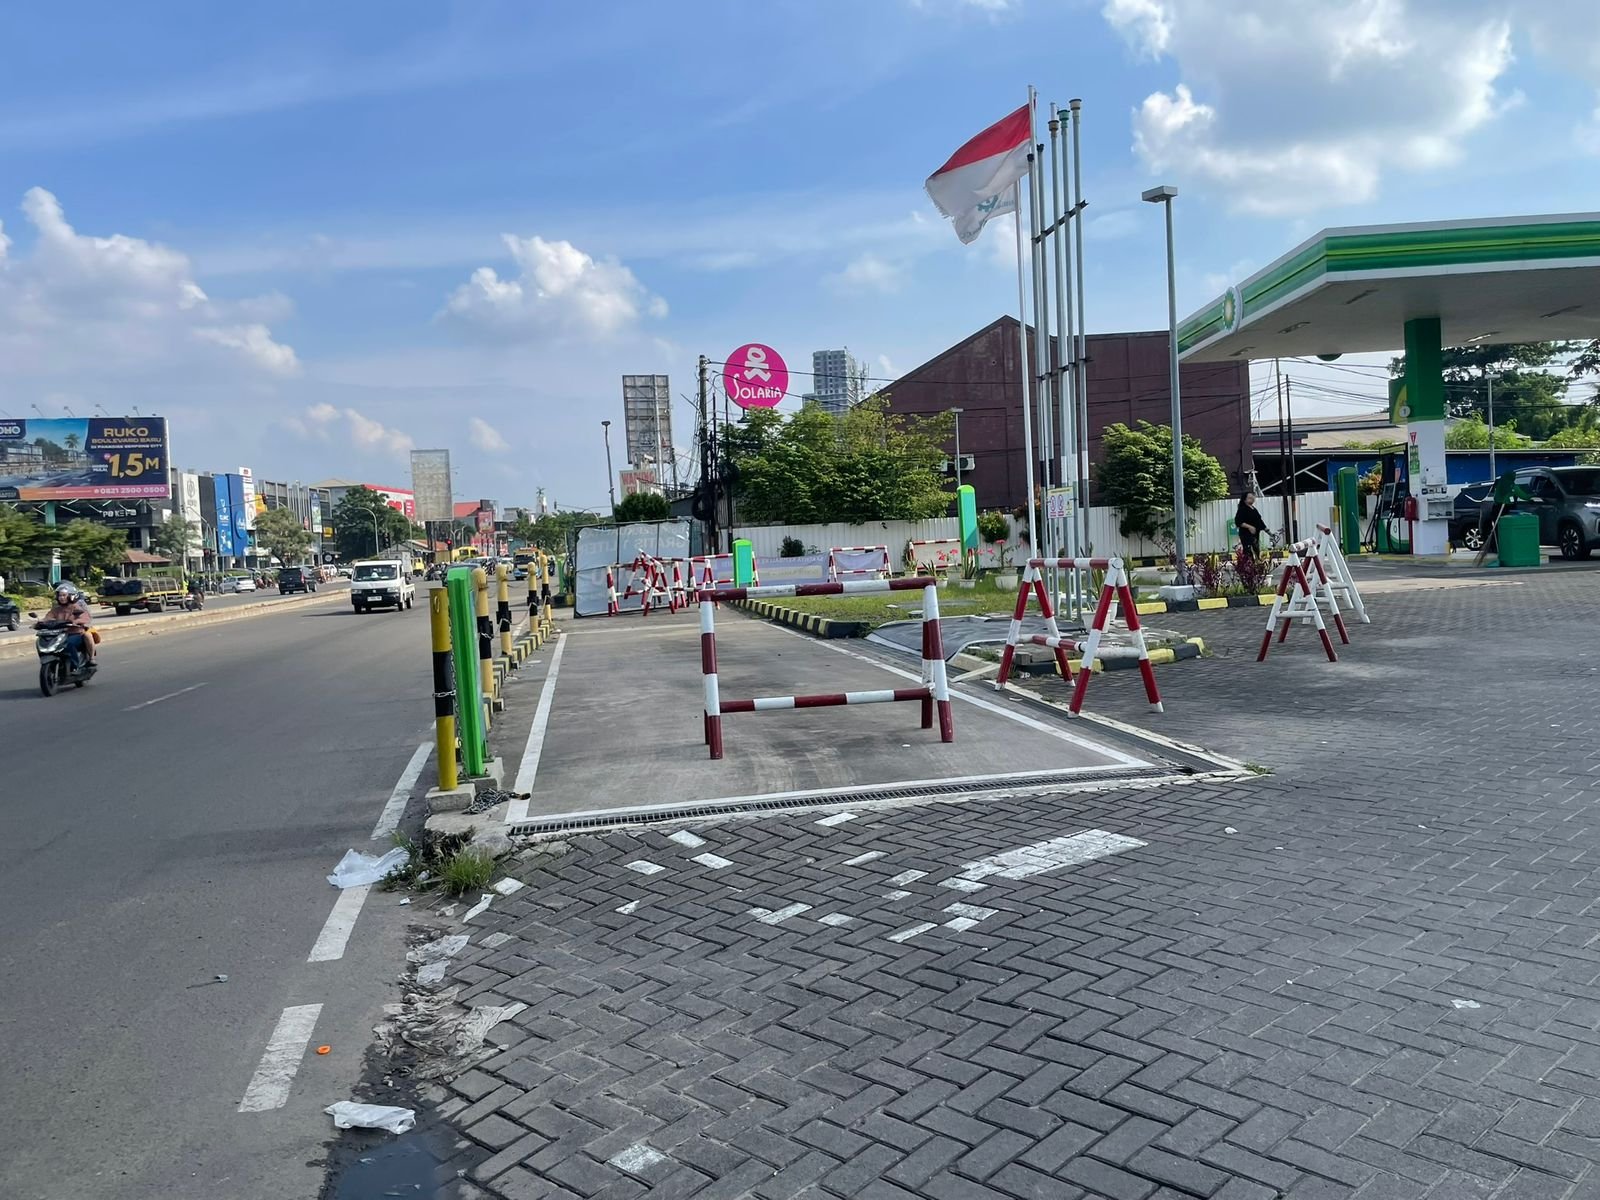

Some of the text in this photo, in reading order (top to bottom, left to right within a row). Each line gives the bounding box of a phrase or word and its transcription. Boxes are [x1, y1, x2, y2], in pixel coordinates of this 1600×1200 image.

[733, 373, 782, 399] SOLARIA
[104, 428, 149, 437] RUKO
[109, 453, 160, 478] 1,5 M
